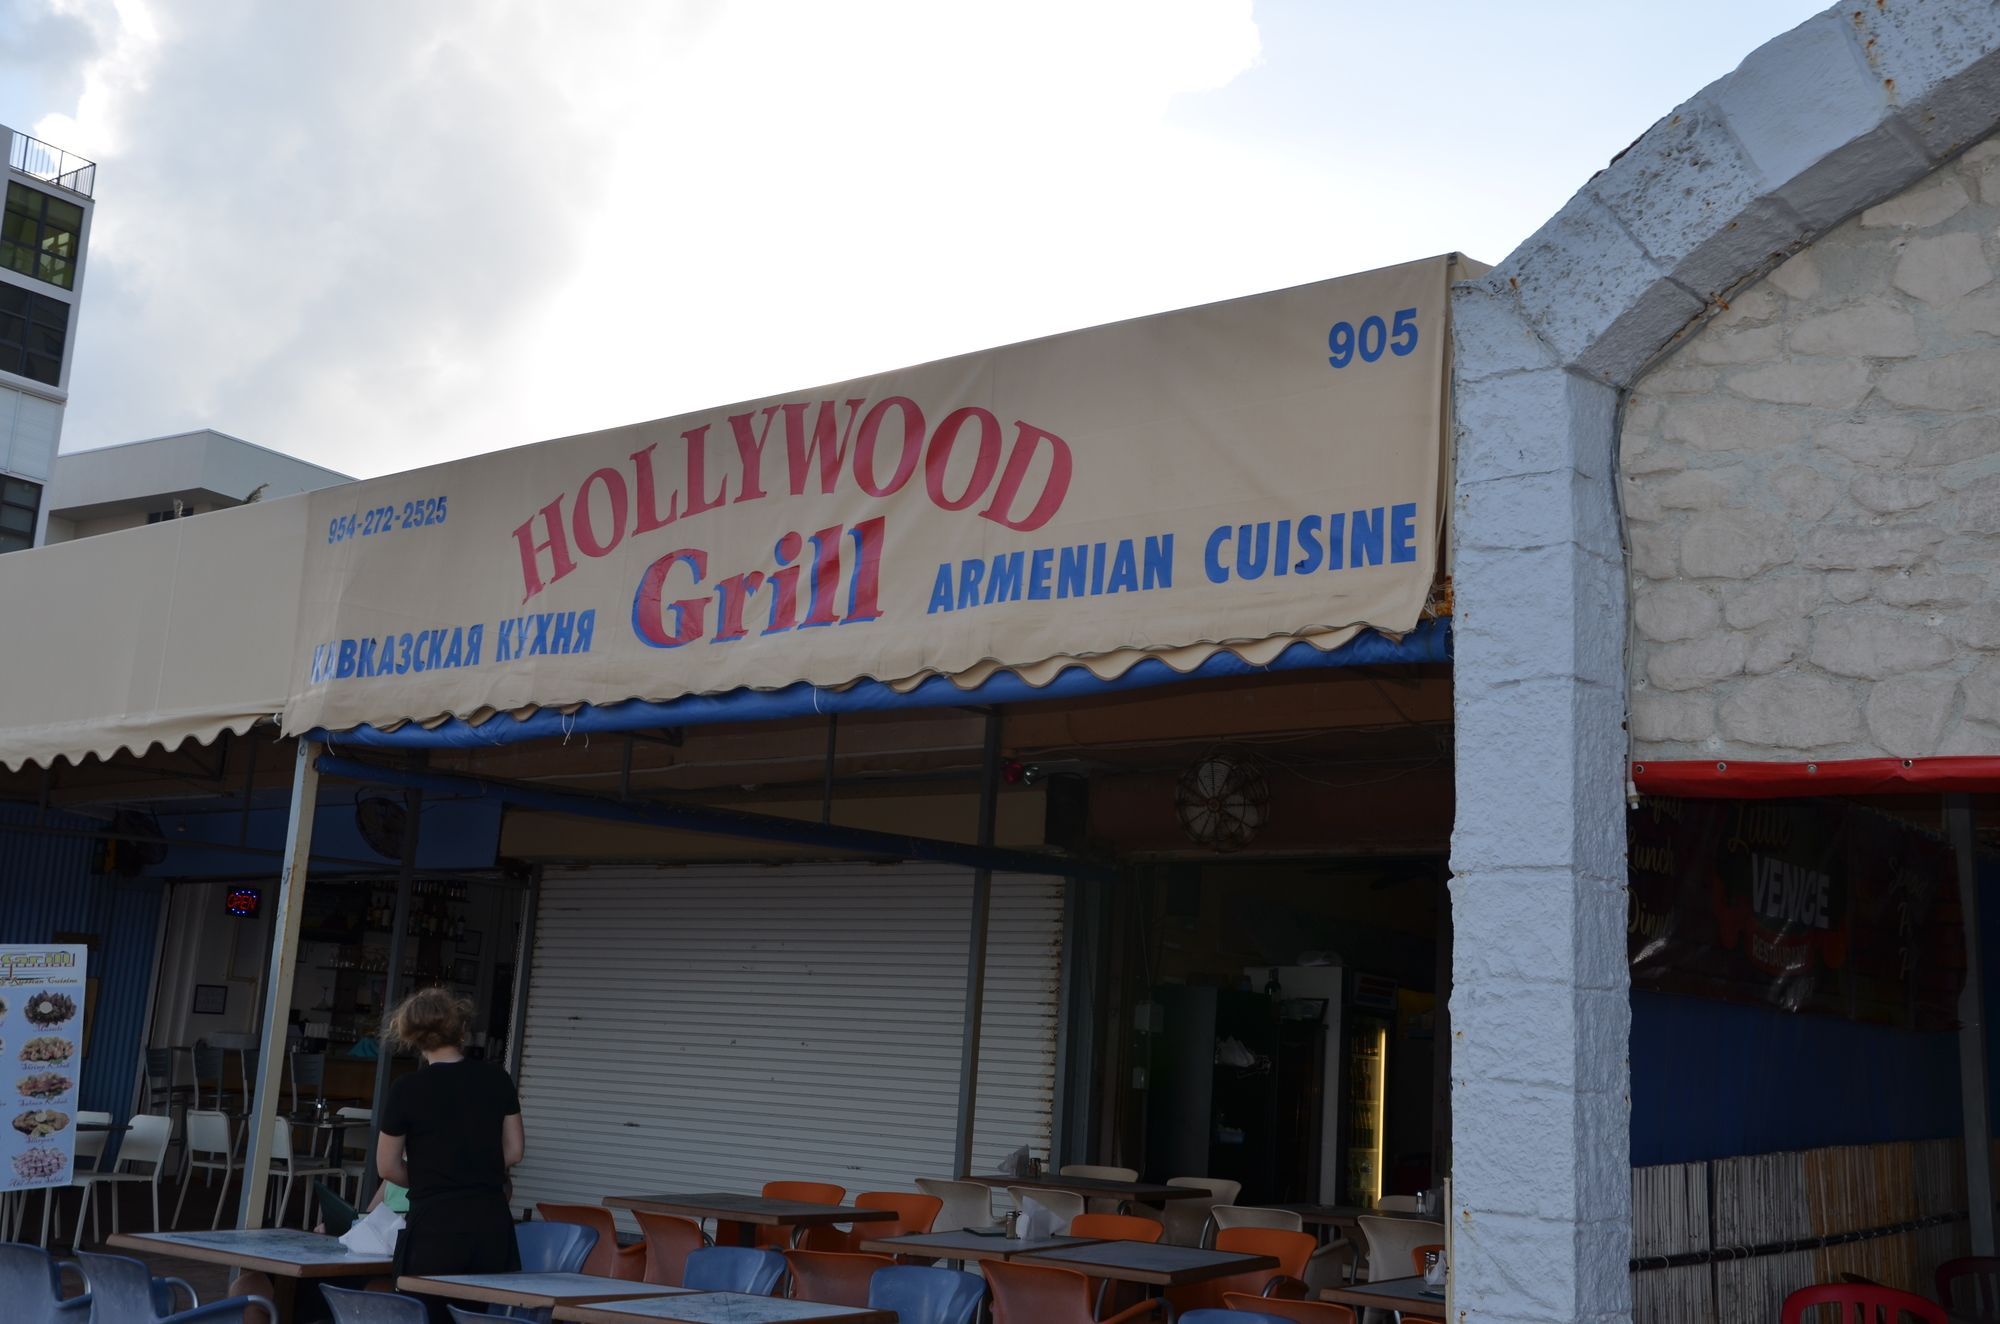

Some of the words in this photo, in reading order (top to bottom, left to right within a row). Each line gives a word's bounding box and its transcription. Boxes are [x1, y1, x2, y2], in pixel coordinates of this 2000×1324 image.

[1328, 307, 1419, 369] 905
[328, 495, 448, 545] 954-272-2525
[512, 395, 1073, 605] HOLLYWOOD
[632, 515, 885, 649] Grill
[926, 533, 1174, 615] ARMENIAN
[1205, 502, 1417, 584] CUISINE
[310, 623, 485, 686] КАВКАЗСКАЯ
[495, 608, 596, 663] КУХНЯ
[226, 890, 256, 909] OPEN
[1751, 851, 1831, 929] VENICE
